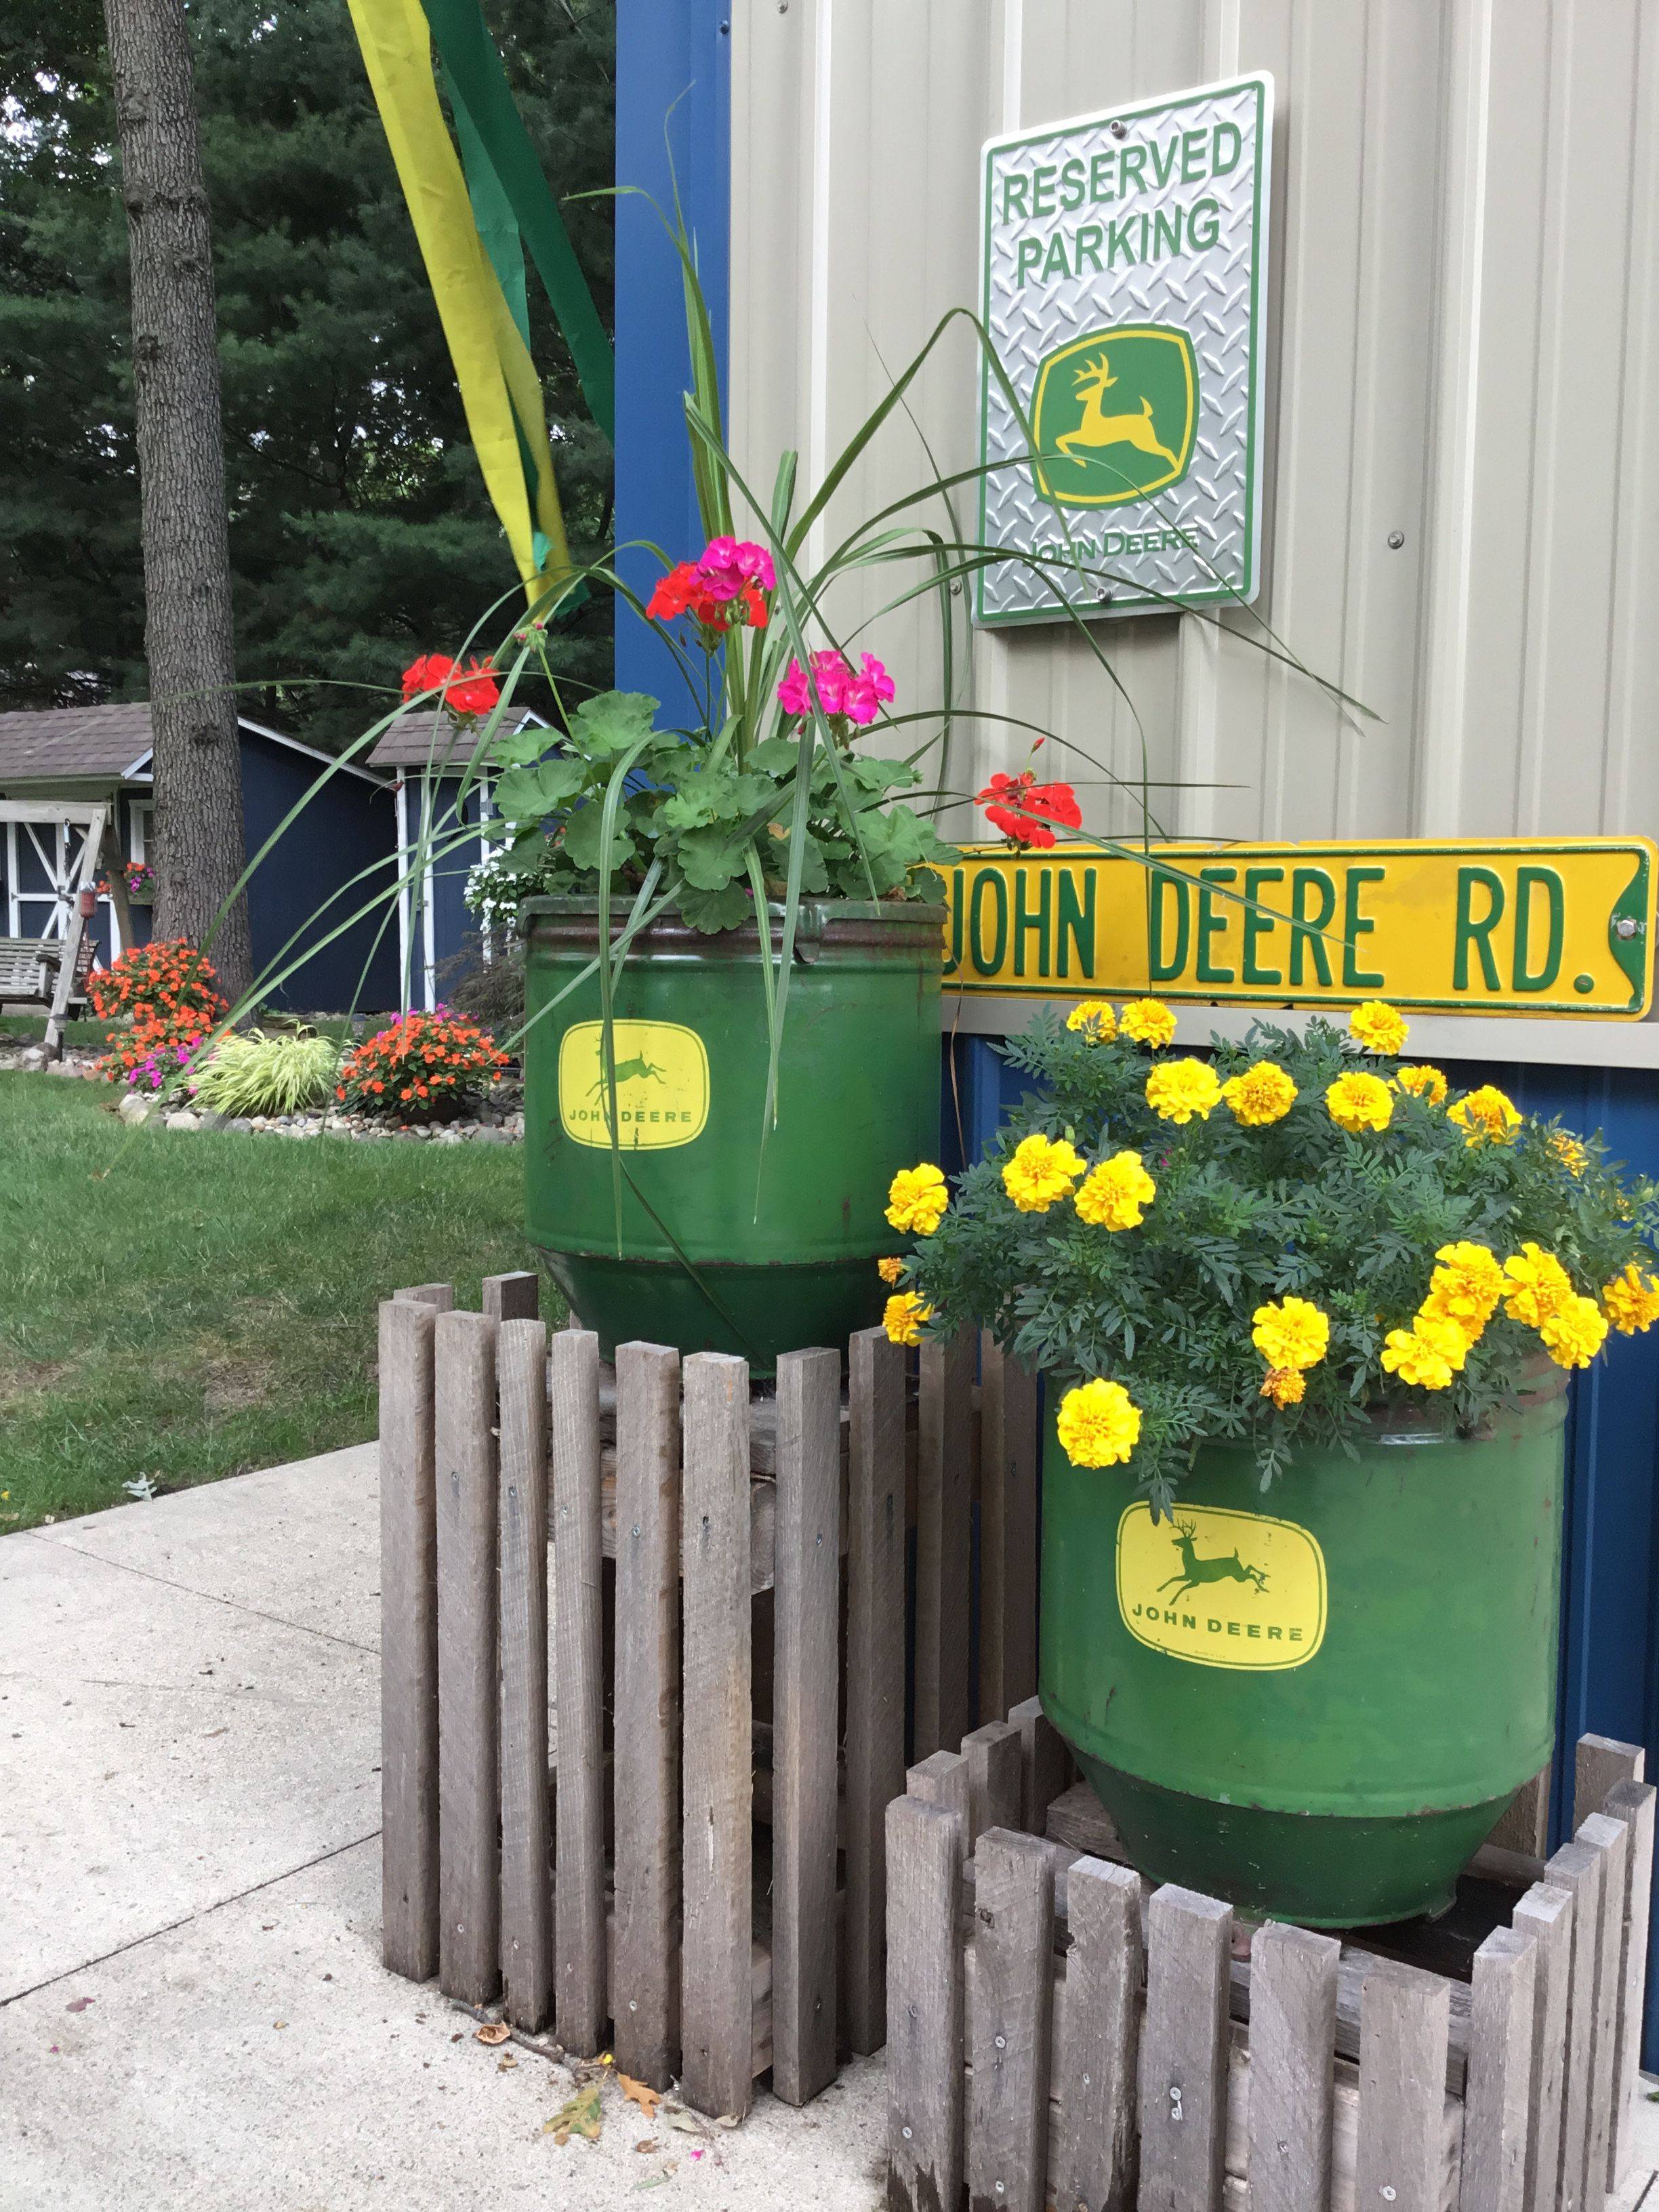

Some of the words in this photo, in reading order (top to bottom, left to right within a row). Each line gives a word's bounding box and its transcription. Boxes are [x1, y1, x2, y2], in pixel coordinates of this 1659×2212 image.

[1002, 121, 1242, 226] RESERVED
[1017, 198, 1220, 289] PARKING
[1103, 524, 1199, 557] DEERE
[941, 867, 1097, 979] JOHN
[1150, 867, 1385, 988] DEERE
[1452, 865, 1595, 994] RD.
[621, 1111, 692, 1123] DEERE
[1132, 1603, 1196, 1630] JOHN
[1207, 1618, 1303, 1642] DEERE
